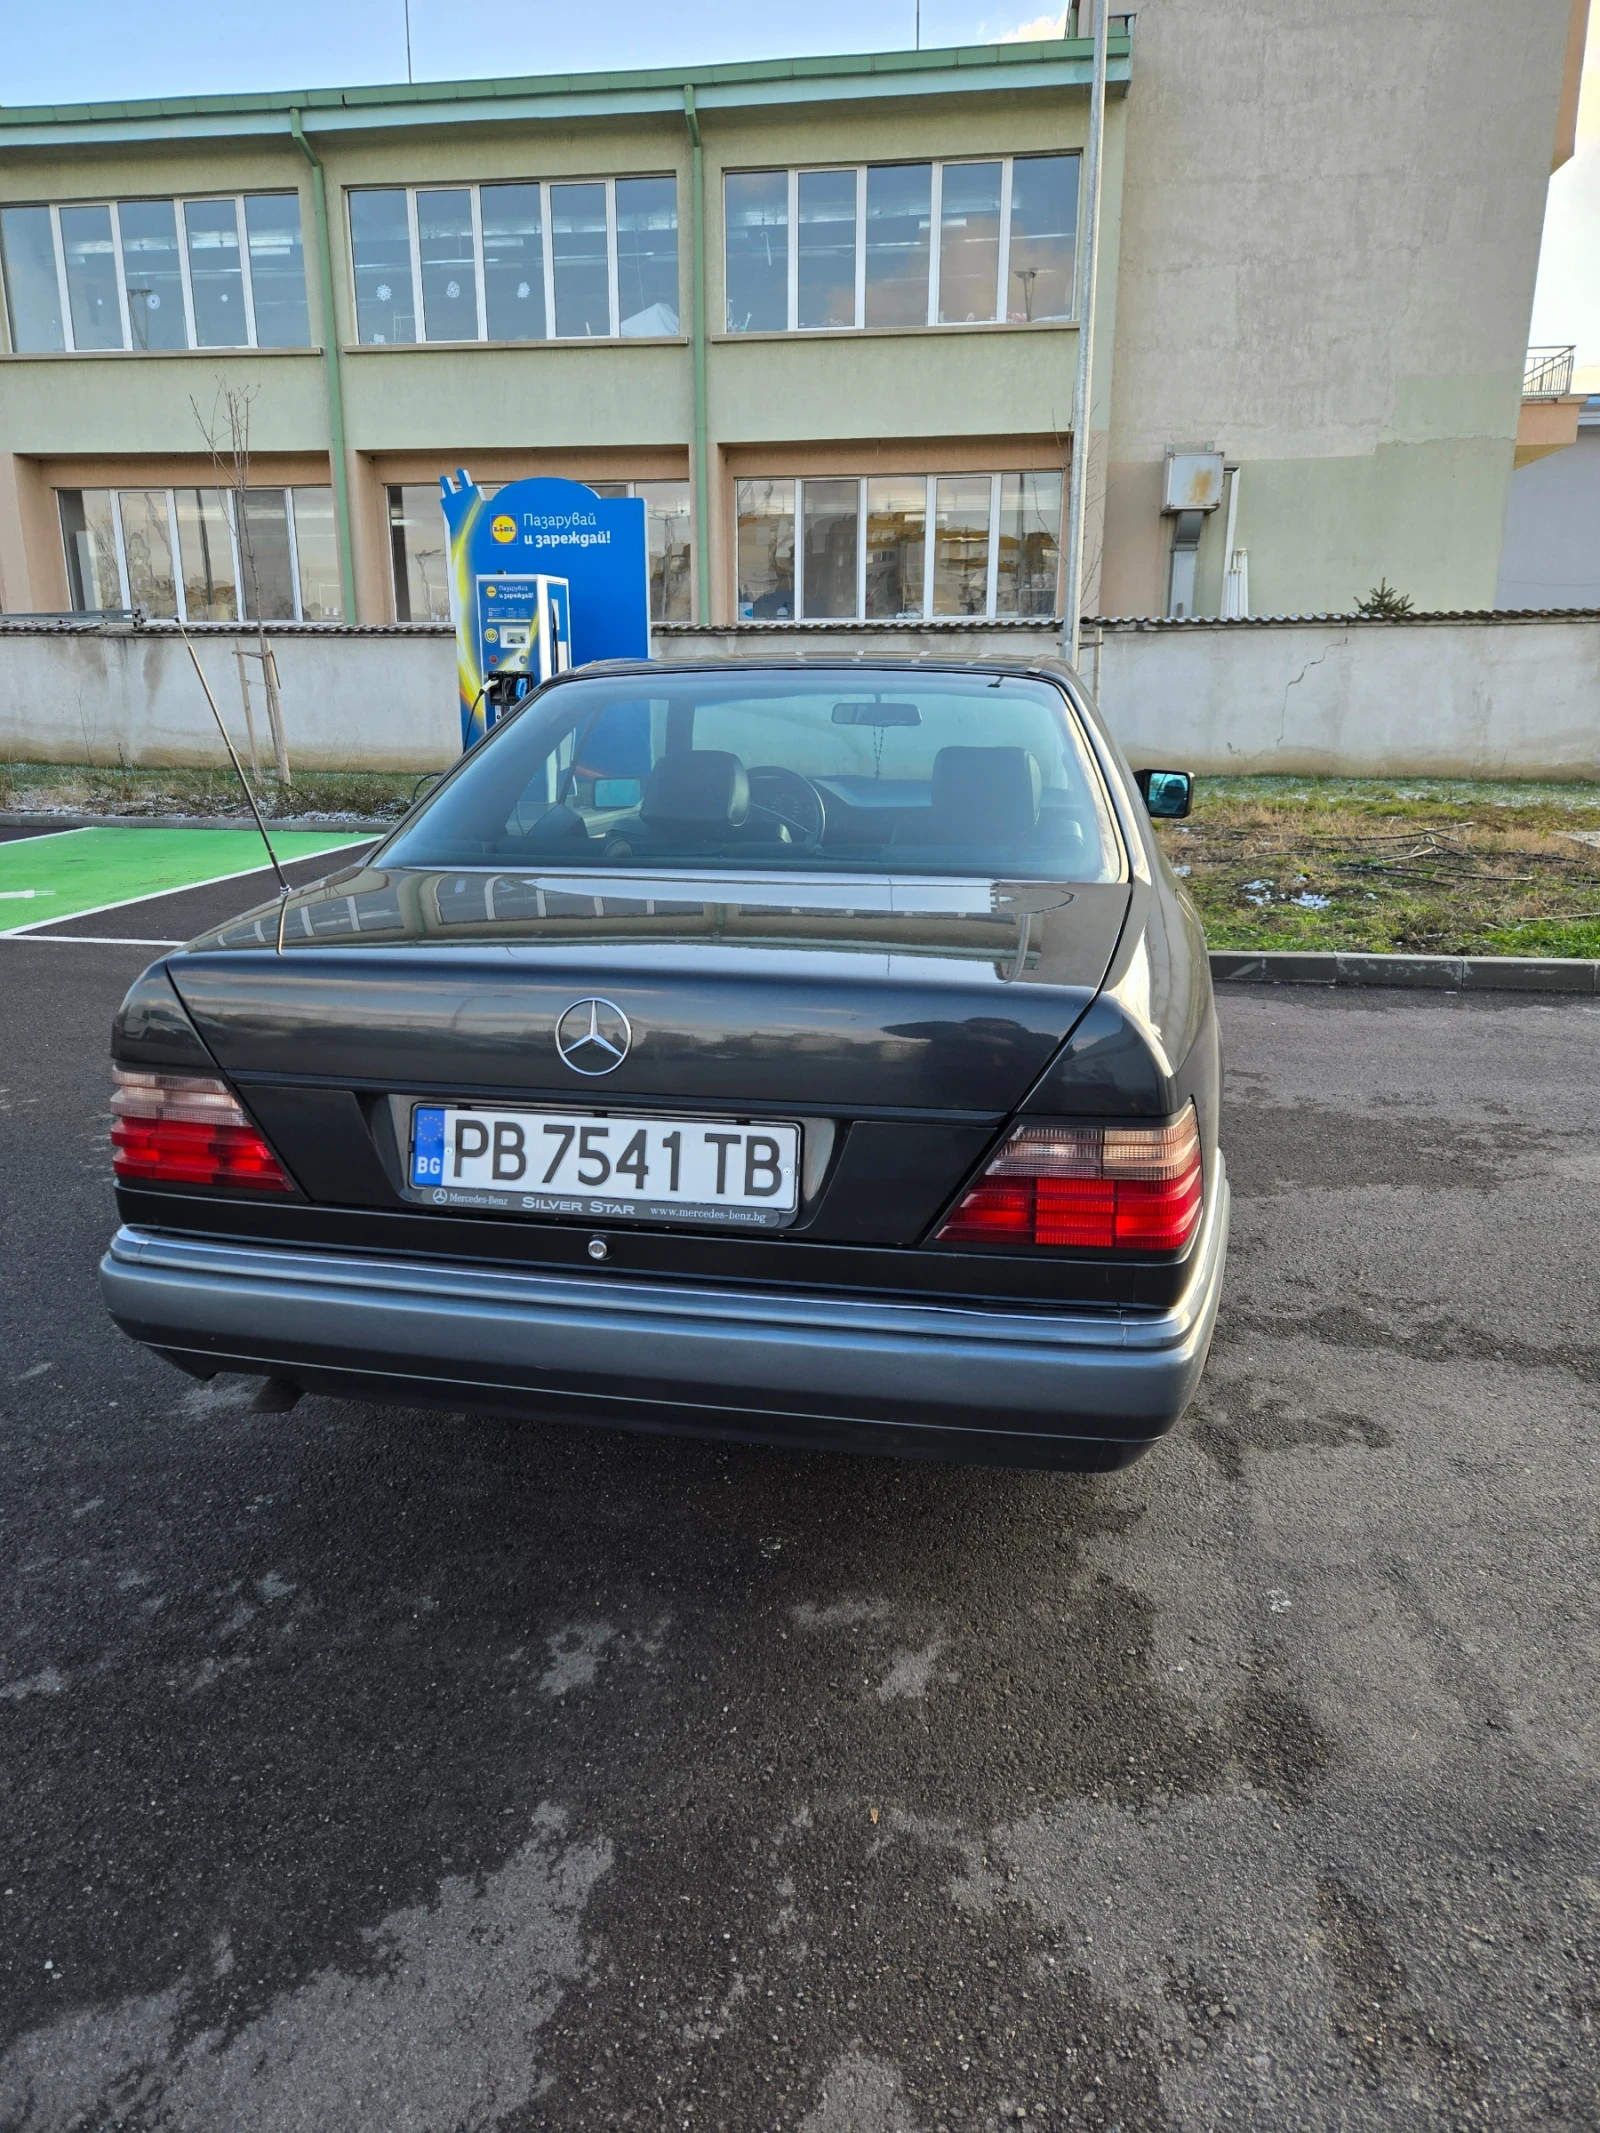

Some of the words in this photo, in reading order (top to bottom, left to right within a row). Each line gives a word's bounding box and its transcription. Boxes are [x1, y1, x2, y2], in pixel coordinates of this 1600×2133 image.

[523, 512, 596, 530] Пазарувай
[524, 535, 533, 545] и
[535, 531, 611, 548] зареждай!
[417, 1156, 440, 1174] BG
[453, 1119, 527, 1181] PB
[541, 1124, 682, 1192] 7541
[704, 1132, 782, 1197] TB
[449, 1193, 508, 1206] Mercedes-Benz
[521, 1196, 582, 1212] SILVER
[589, 1200, 636, 1215] STAR
[650, 1206, 766, 1224] www.mercedes-benz.bg
